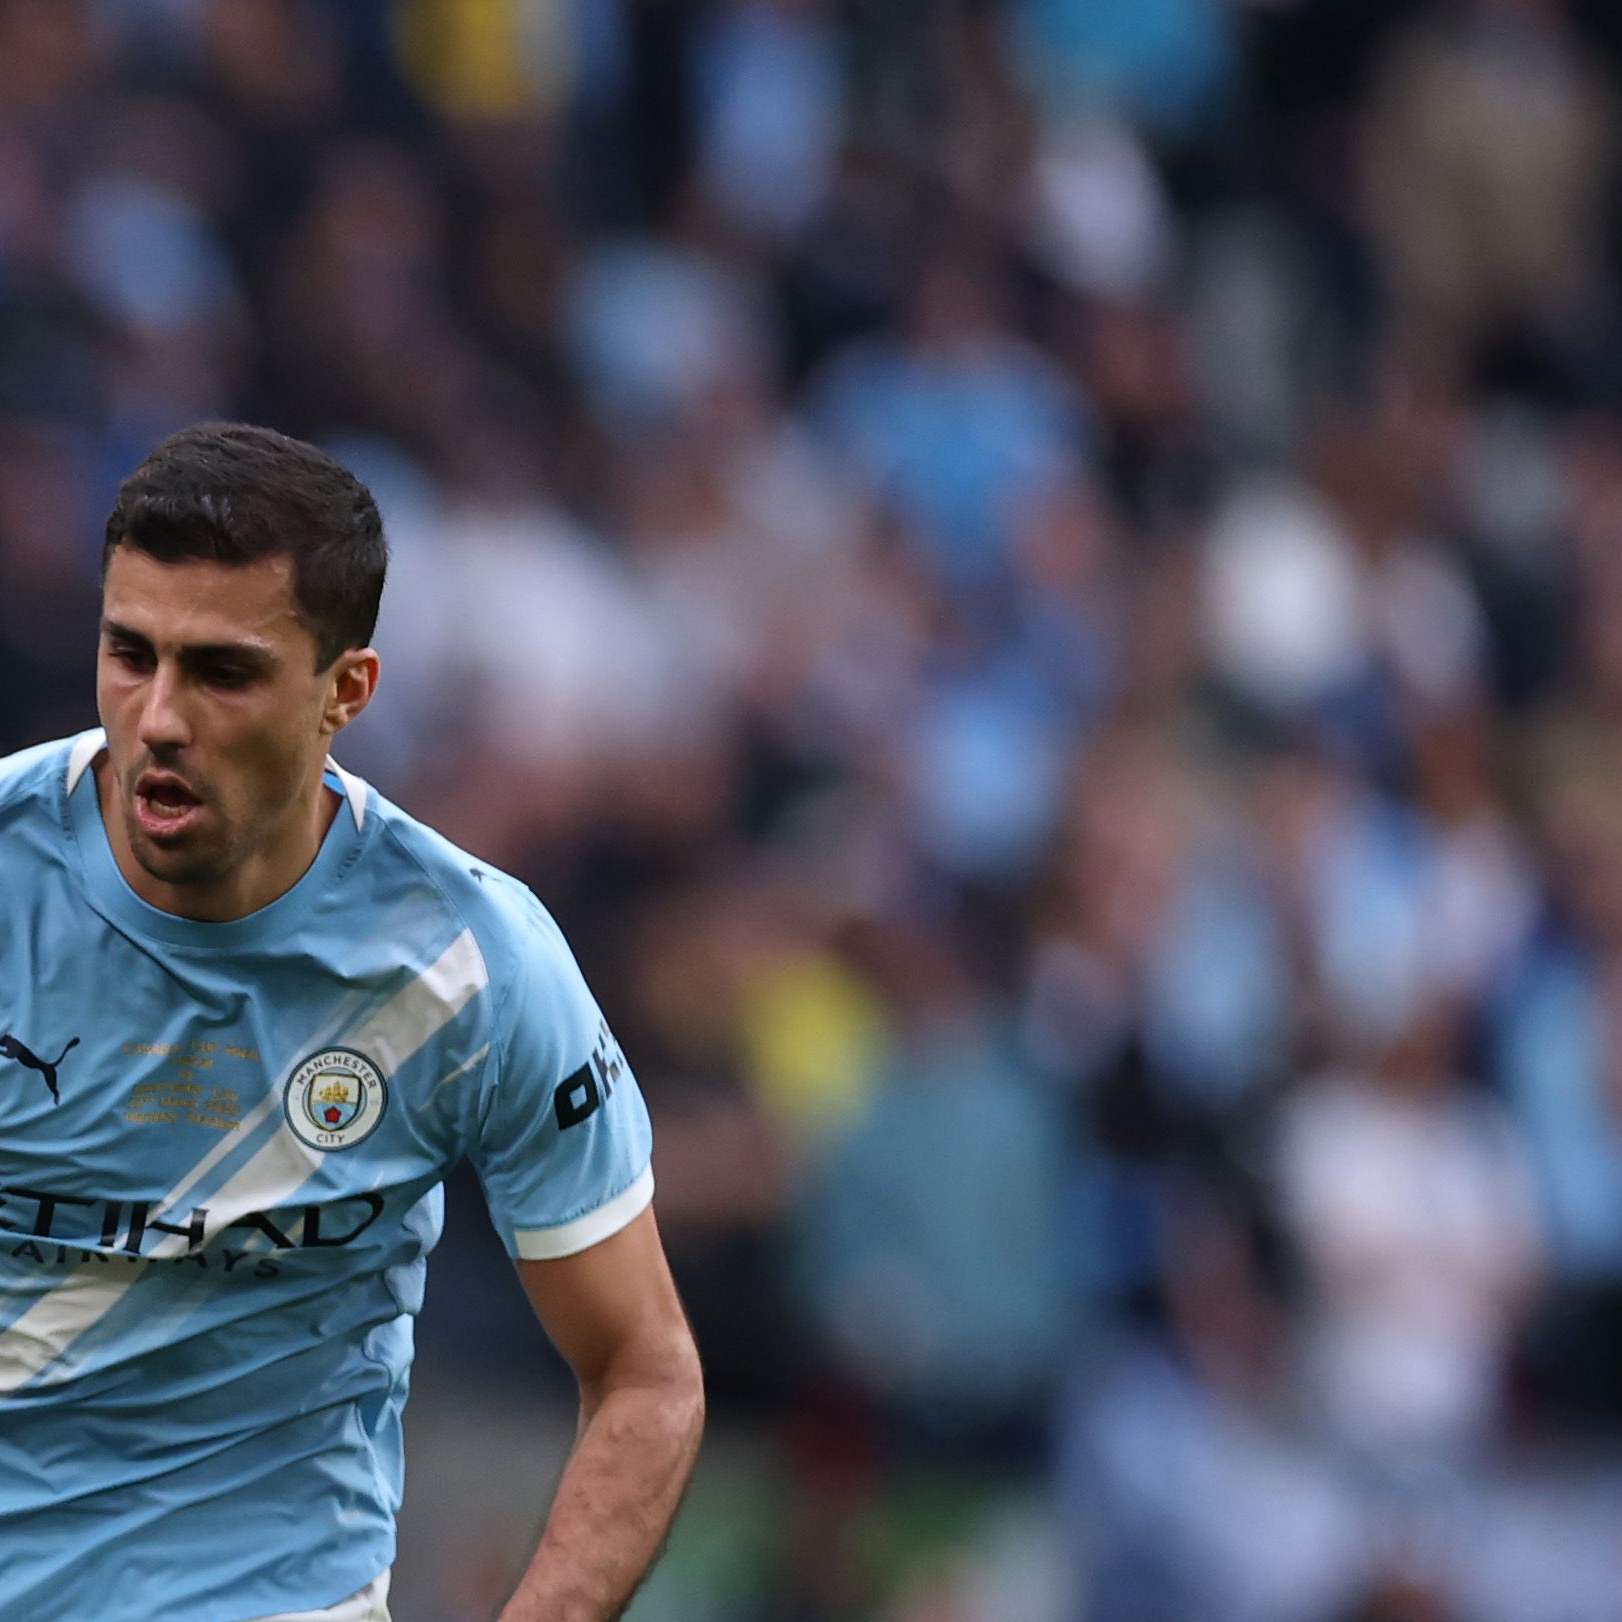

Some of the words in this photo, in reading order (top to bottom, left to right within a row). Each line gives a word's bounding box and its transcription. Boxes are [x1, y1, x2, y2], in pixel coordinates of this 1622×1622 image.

[297, 1055, 377, 1088] MANCHESTER
[316, 1133, 346, 1144] CITY
[11, 1241, 283, 1278] AIRAYS
